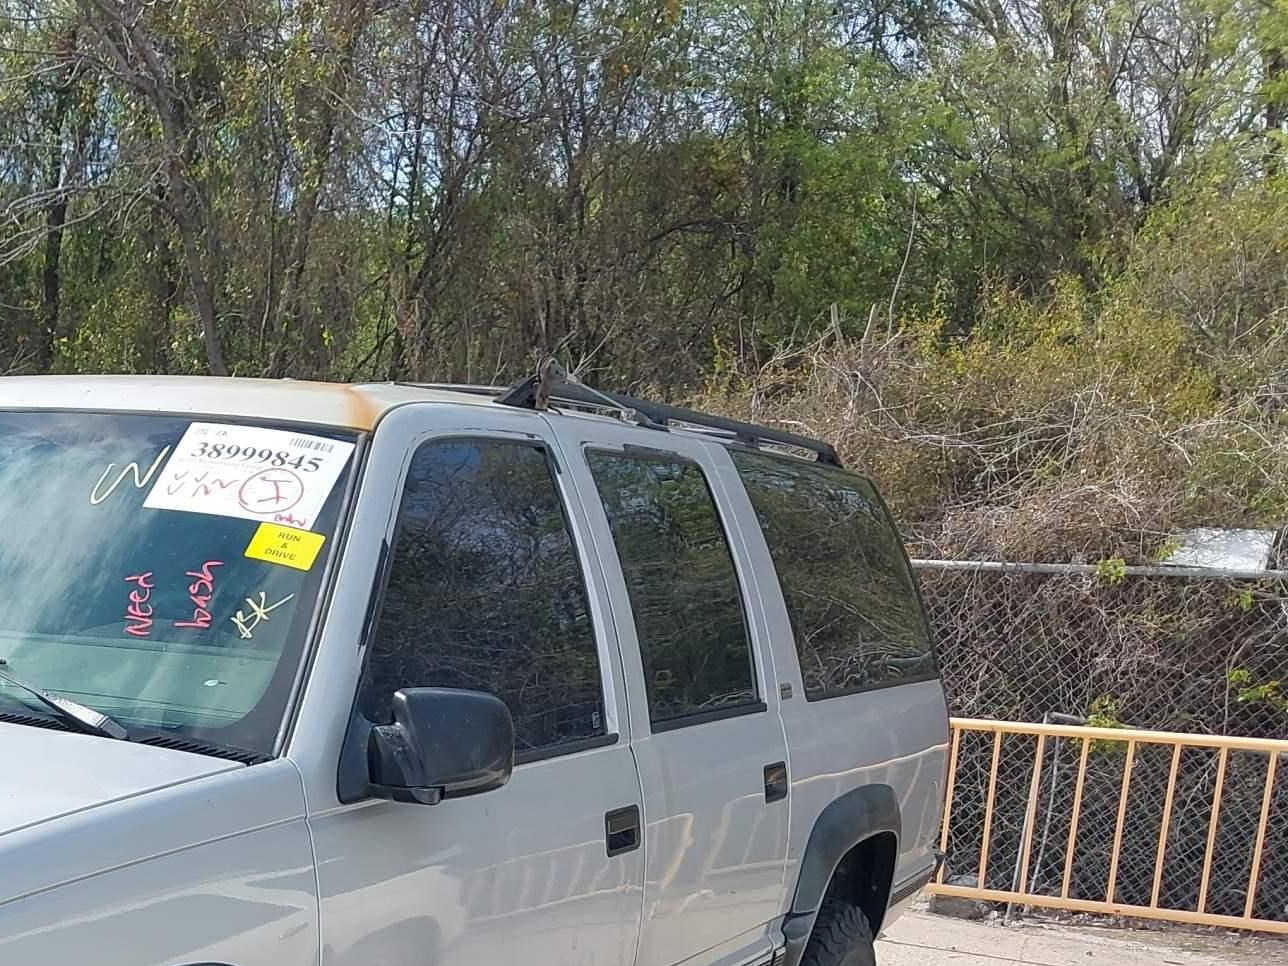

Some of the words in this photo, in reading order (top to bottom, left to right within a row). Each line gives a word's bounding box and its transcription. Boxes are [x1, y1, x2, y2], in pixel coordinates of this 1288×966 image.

[190, 441, 325, 473] 38999845
[277, 531, 302, 542] RUN
[280, 541, 289, 550] &
[264, 547, 297, 561] DRIVE
